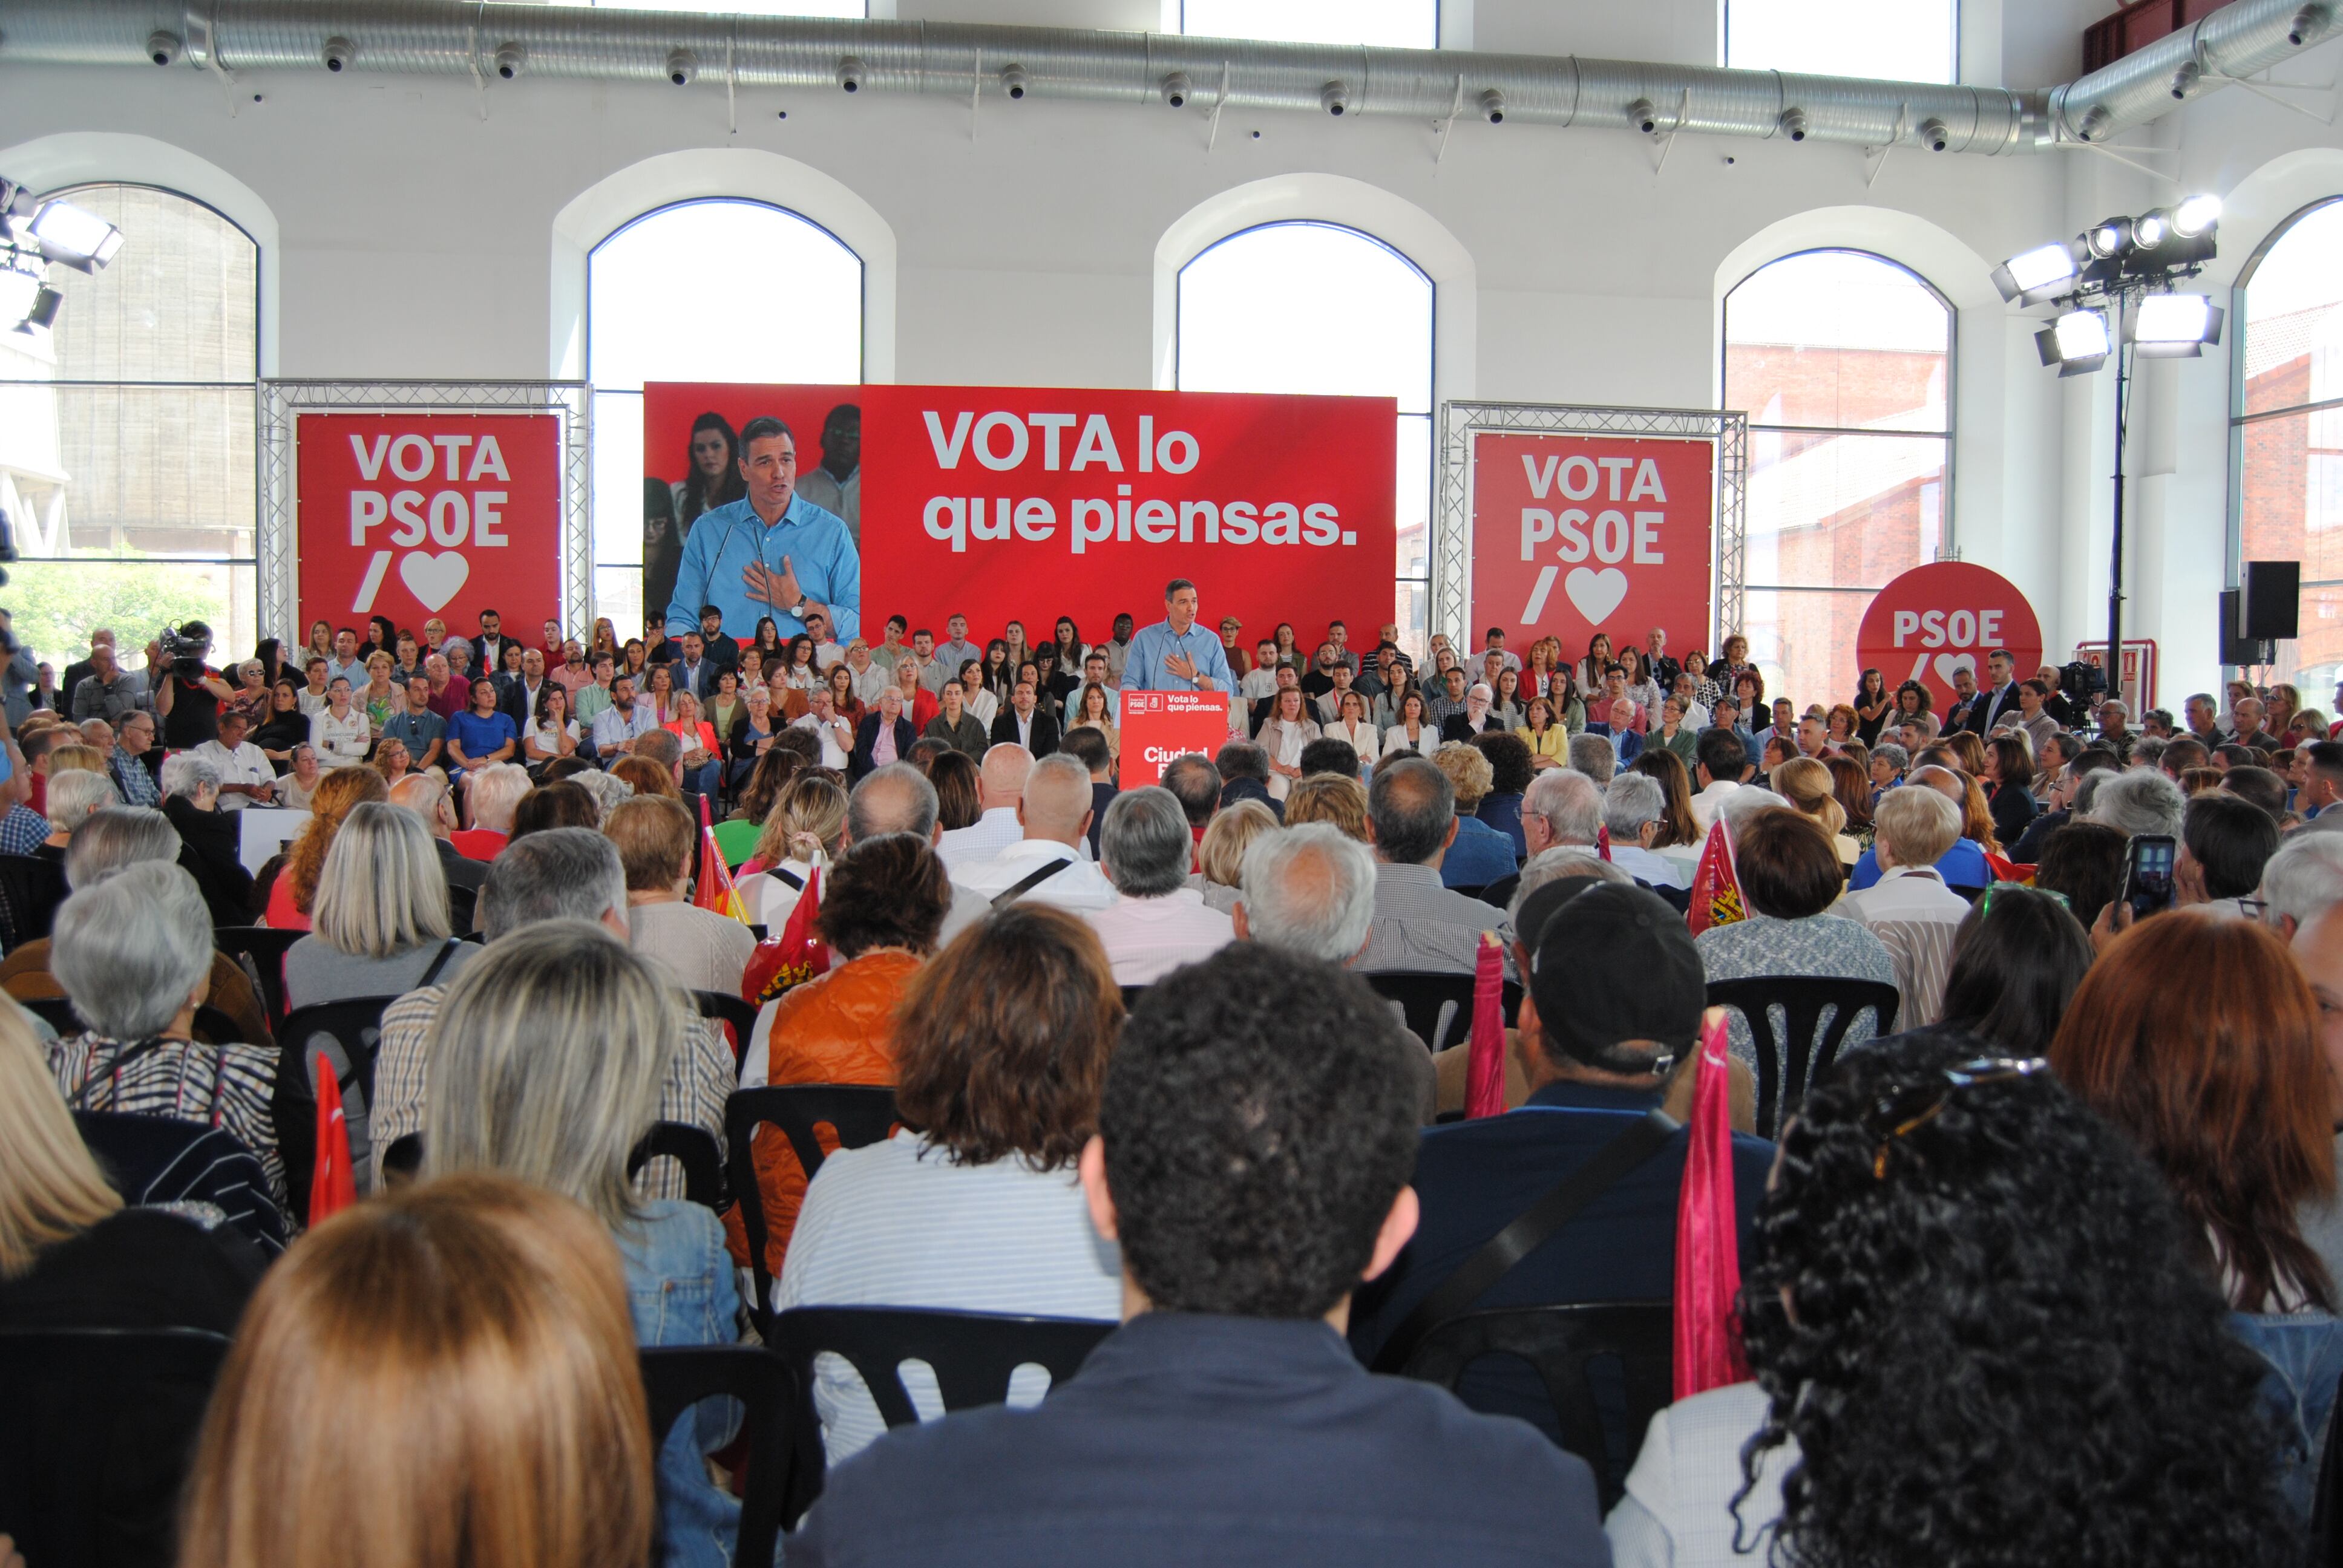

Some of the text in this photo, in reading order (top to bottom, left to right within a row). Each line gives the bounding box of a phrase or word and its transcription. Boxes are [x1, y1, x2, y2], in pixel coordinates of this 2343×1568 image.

[350, 434, 510, 482] VOTA
[923, 411, 1199, 474] VOTA lo
[1521, 455, 1666, 502] VOTA
[351, 490, 508, 547] PSOE
[923, 485, 1357, 554] que piensas.
[1521, 508, 1664, 564] PSOE
[1893, 610, 2004, 648] PSOE
[1167, 694, 1199, 703] Vota lo
[1185, 703, 1223, 713] piensas.
[1144, 746, 1208, 762] Ciudd
